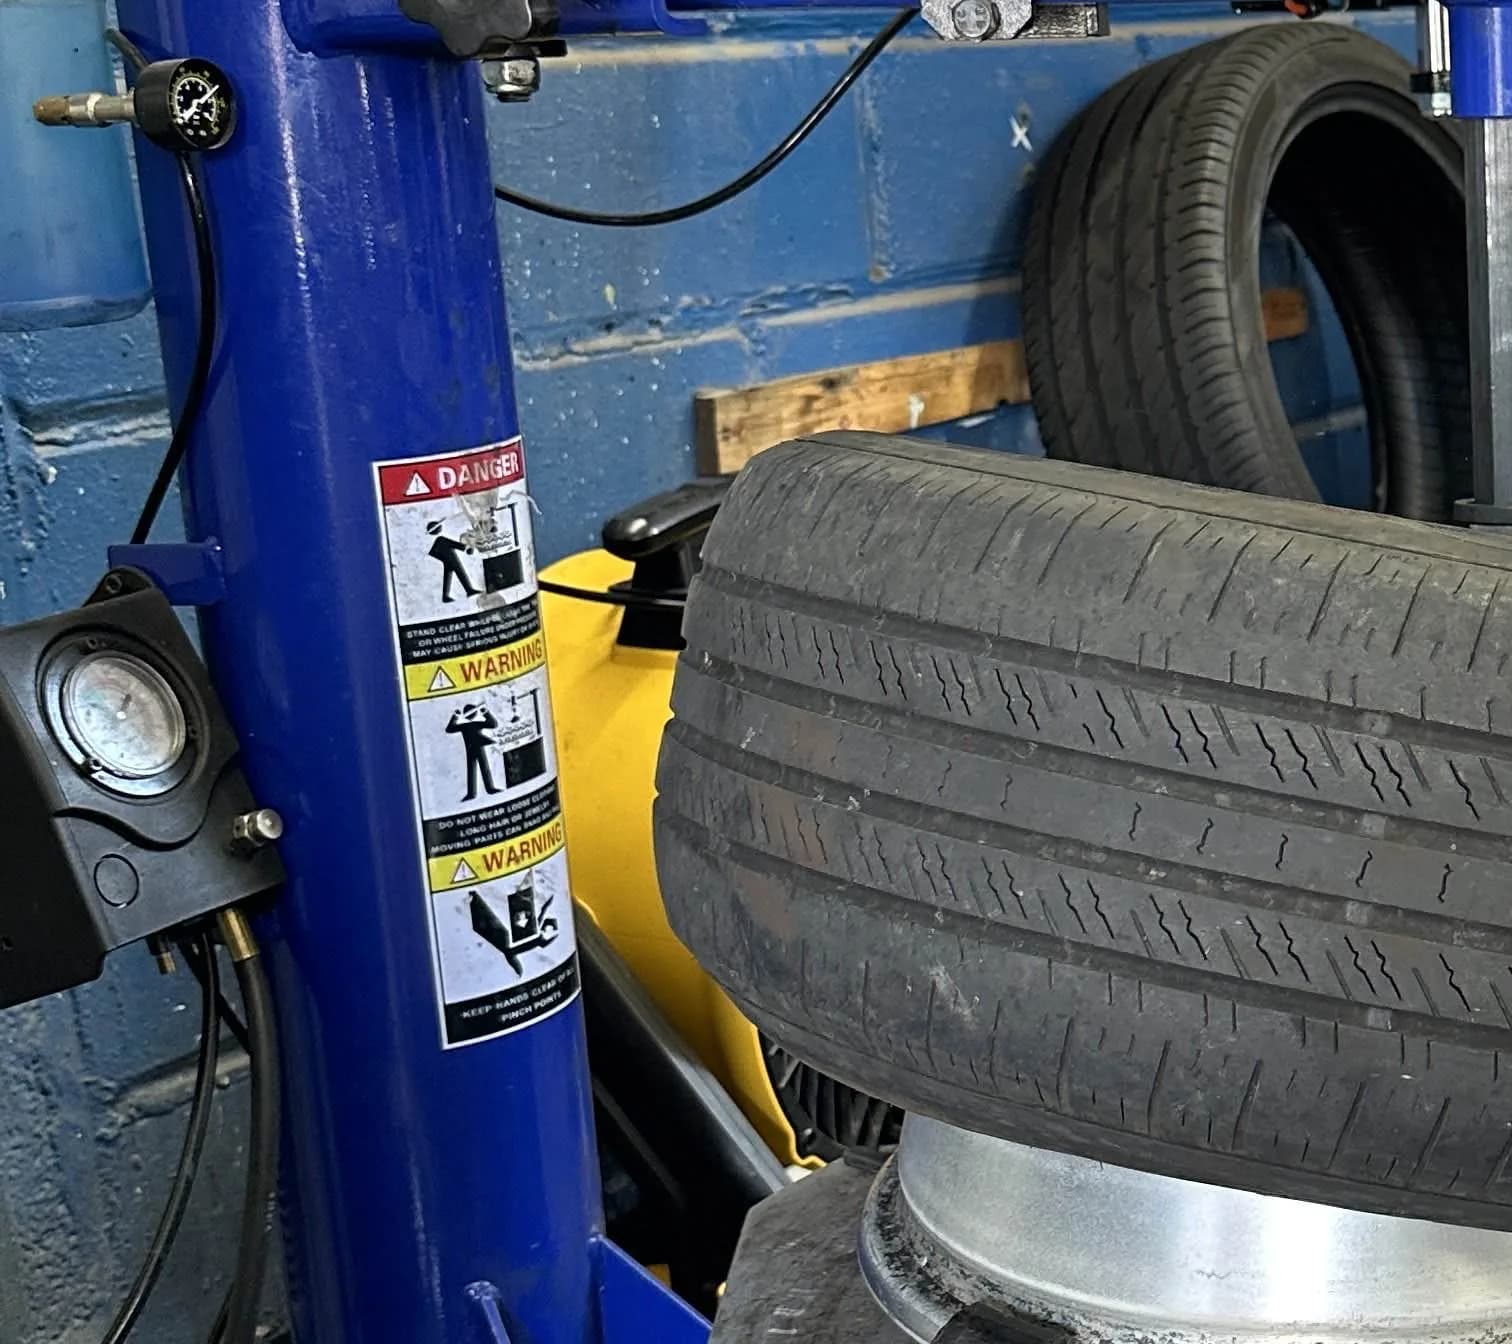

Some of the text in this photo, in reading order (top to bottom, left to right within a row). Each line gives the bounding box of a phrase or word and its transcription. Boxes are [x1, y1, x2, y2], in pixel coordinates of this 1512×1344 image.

[437, 451, 520, 491] DANGER
[406, 624, 436, 639] STAND
[438, 620, 466, 635] CLEAR
[433, 632, 463, 646] WHEEL
[463, 624, 495, 640] FAILURE
[412, 648, 432, 658] MAY
[465, 635, 499, 650] SERIOUS
[460, 637, 543, 684] WARNING
[438, 819, 454, 831] DO
[456, 813, 477, 827] NOT
[478, 806, 506, 822] WEAR
[459, 823, 488, 838] LONG
[489, 815, 512, 831] HAIR
[430, 839, 472, 854] MOVING
[474, 830, 505, 845] PARTS
[505, 822, 522, 837] CAN
[481, 820, 562, 873] WARNING
[461, 1003, 493, 1020] KEEP
[494, 991, 530, 1010] HANDS
[530, 977, 557, 997] CLEAR
[500, 989, 562, 1023] PINCH POINTS
